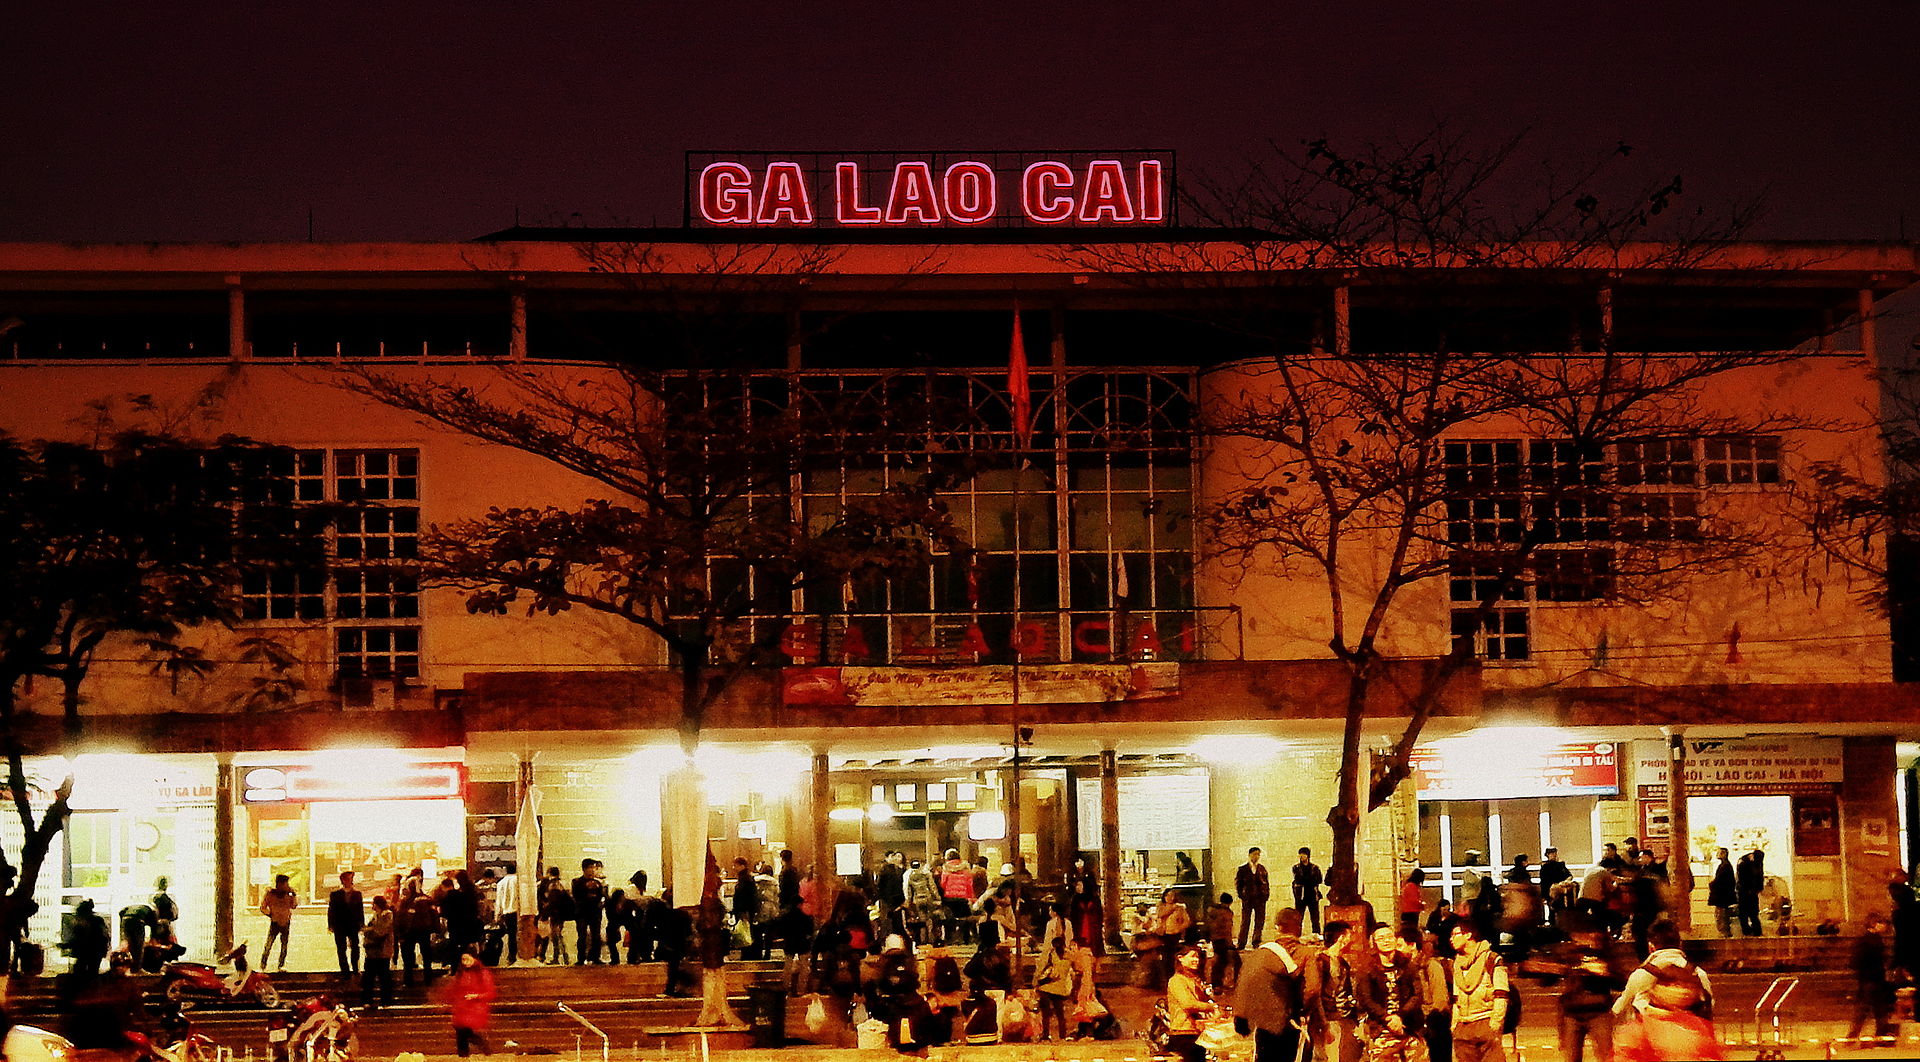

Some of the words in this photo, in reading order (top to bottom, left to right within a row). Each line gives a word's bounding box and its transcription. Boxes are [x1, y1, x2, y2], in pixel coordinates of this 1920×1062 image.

[699, 161, 812, 224] GA
[836, 160, 996, 223] LAO
[1022, 160, 1163, 223] CAI
